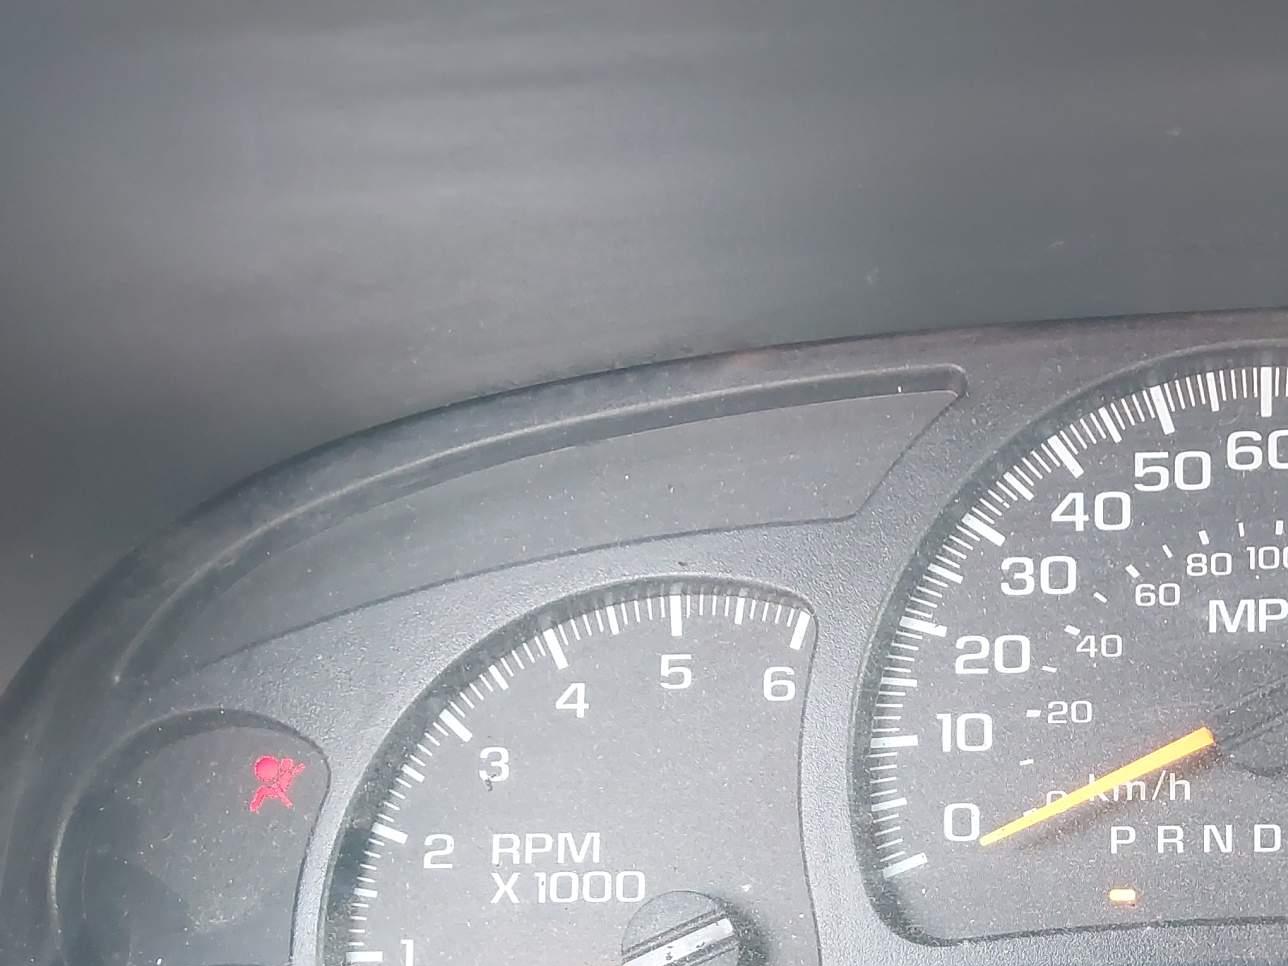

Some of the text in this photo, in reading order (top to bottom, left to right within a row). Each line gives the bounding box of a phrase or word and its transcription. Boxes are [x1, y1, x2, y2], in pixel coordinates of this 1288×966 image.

[1134, 451, 1210, 491] 50
[1051, 492, 1131, 531] 40
[1000, 556, 1076, 595] 30
[1186, 553, 1232, 575] 80
[1135, 583, 1180, 607] 60
[955, 635, 1030, 674] 20
[1076, 634, 1122, 657] 40
[660, 654, 692, 689] 5
[763, 666, 795, 700] 6
[556, 683, 589, 718] 4
[1047, 701, 1092, 723] 20
[936, 713, 992, 752] 10
[479, 747, 509, 782] 3
[944, 803, 980, 842] 0
[1111, 826, 1135, 853] P
[1158, 825, 1183, 853] R
[1204, 825, 1232, 853] N
[1254, 824, 1281, 852] D
[424, 834, 454, 869] 2
[492, 833, 600, 864] RPM
[491, 871, 645, 903] X 1000
